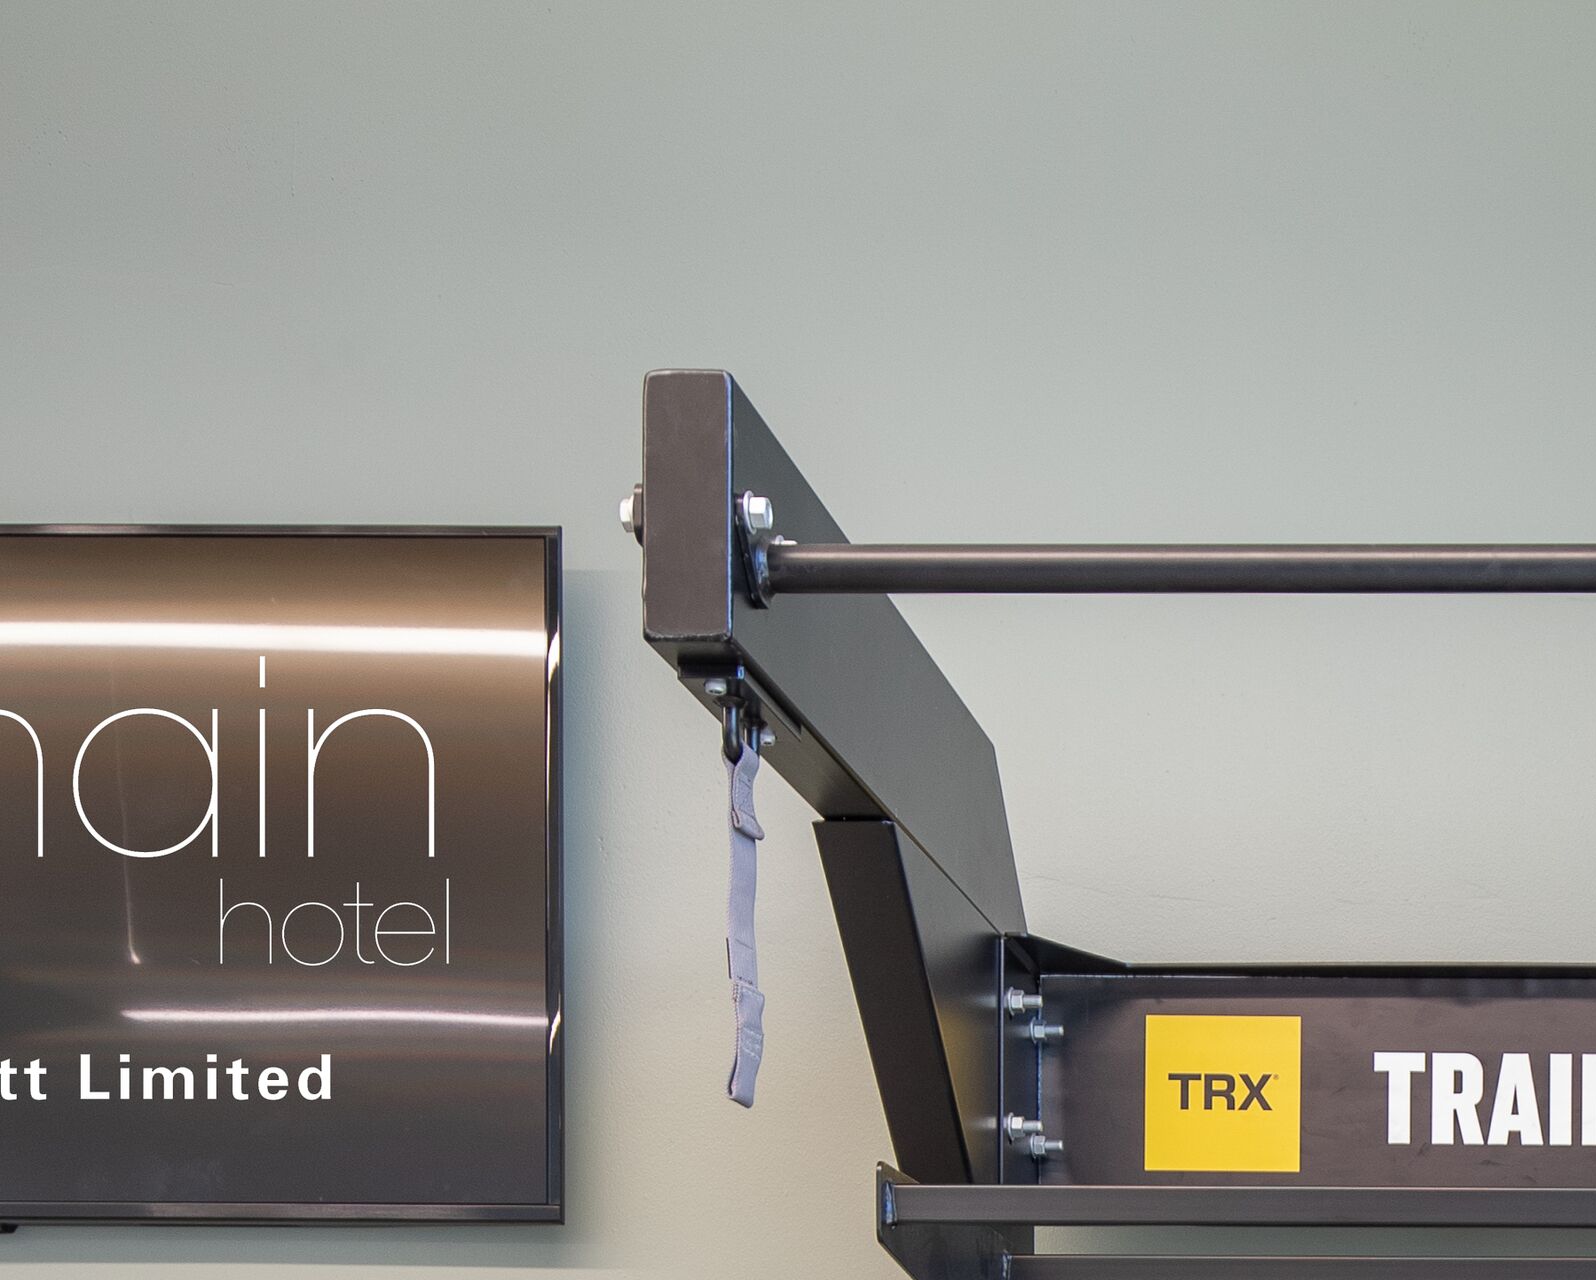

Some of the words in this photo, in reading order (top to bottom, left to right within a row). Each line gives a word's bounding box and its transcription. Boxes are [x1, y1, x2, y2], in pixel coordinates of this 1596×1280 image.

[220, 878, 450, 966] hotel
[81, 1054, 332, 1101] Limited
[1168, 1073, 1273, 1111] TRX
